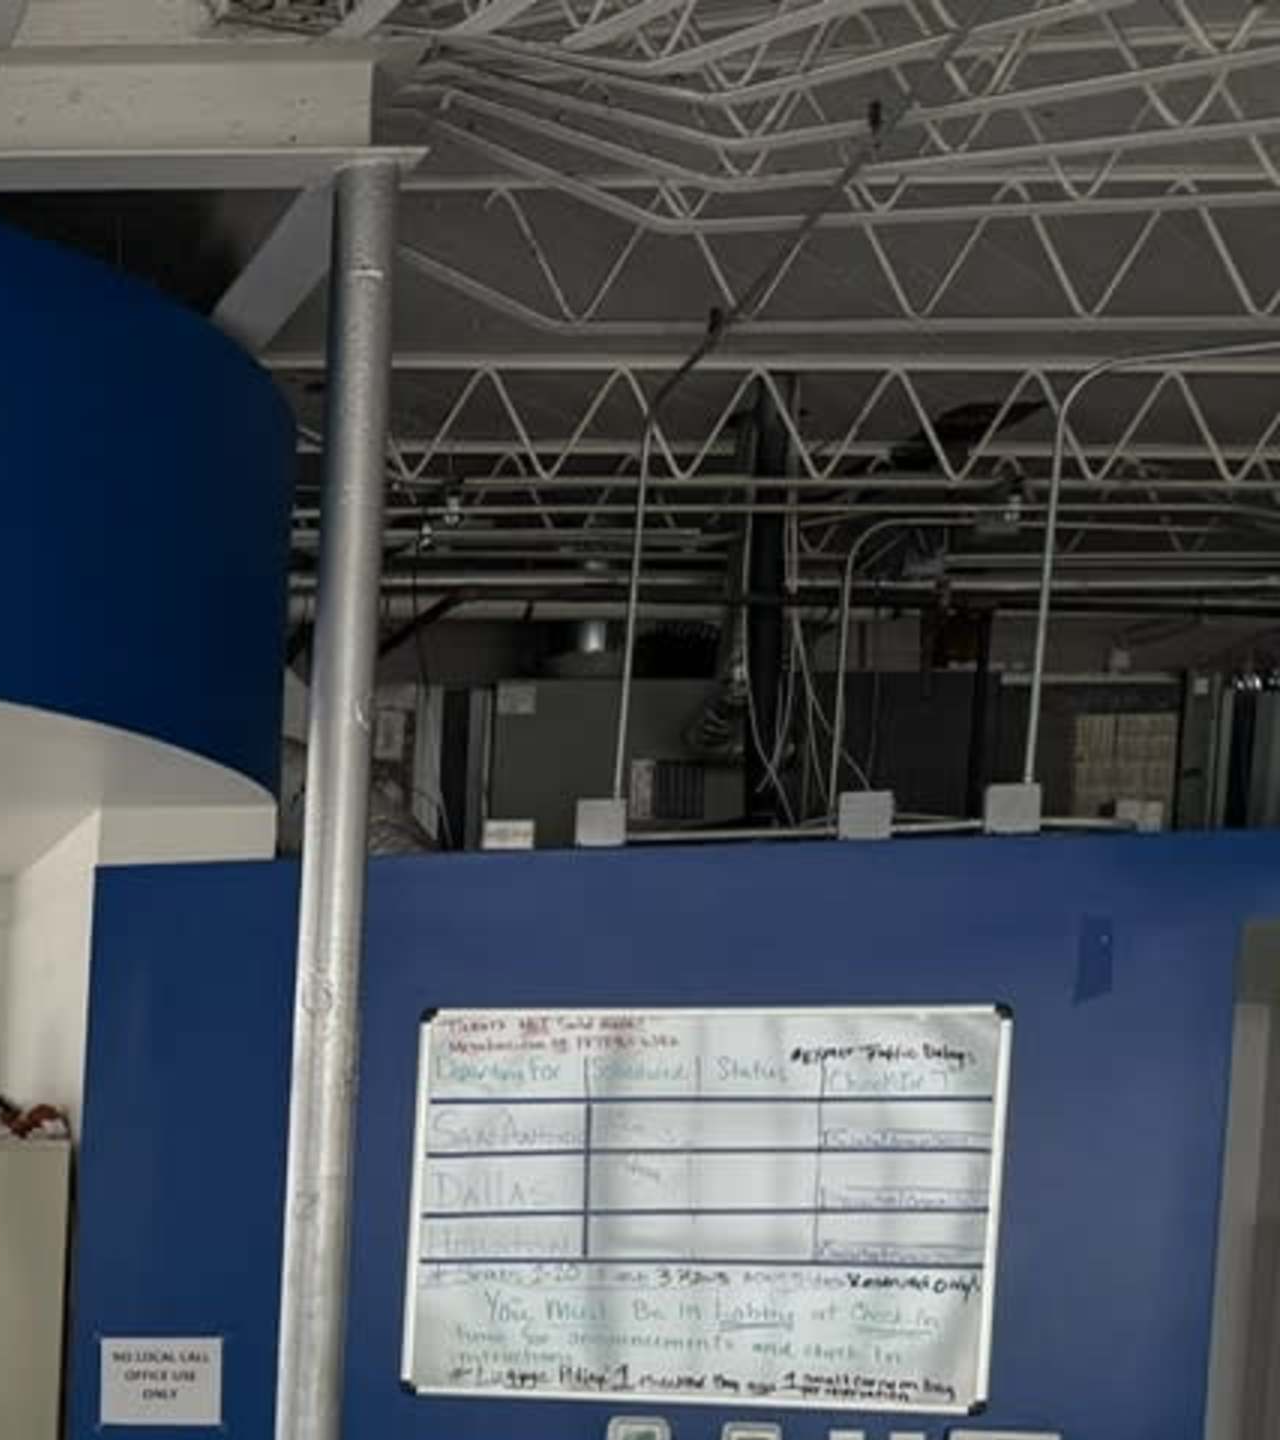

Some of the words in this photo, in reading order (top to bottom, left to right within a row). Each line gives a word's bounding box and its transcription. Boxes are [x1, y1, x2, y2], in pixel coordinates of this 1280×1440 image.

[112, 1351, 132, 1363] NO
[136, 1351, 176, 1363] LOCAL
[178, 1351, 209, 1363] CALL
[124, 1370, 167, 1382] OFFICE
[172, 1370, 196, 1382] USE
[142, 1388, 178, 1400] ONLY
